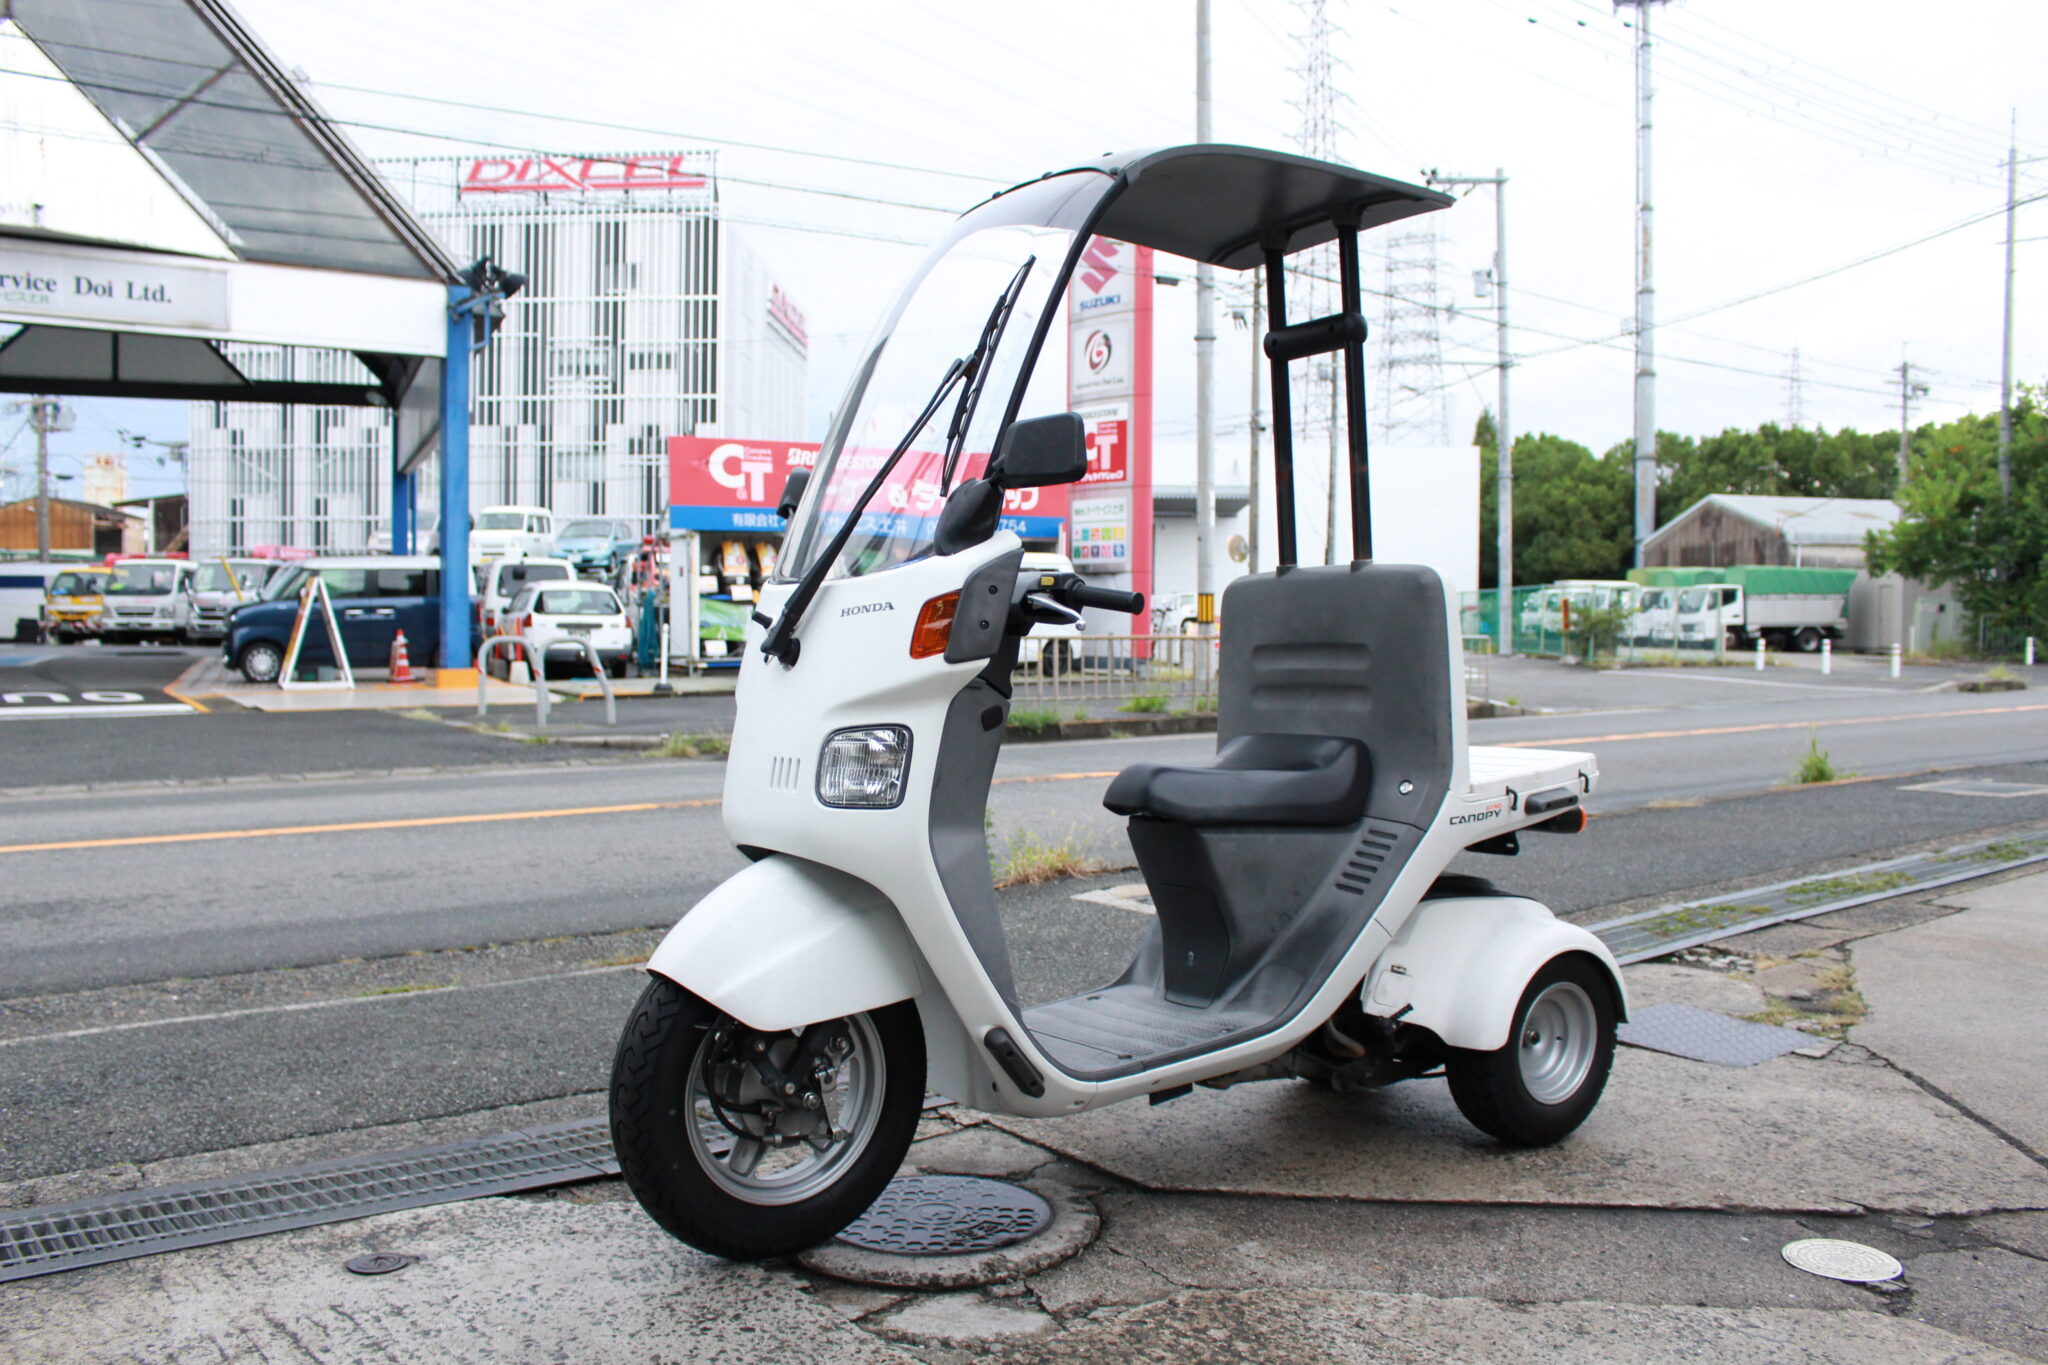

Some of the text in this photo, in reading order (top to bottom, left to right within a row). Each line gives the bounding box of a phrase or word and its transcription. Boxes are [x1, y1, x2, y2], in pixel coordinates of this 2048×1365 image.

[73, 275, 114, 298] Doi
[126, 281, 173, 303] Ltd.
[1080, 294, 1121, 310] SUZUKI
[840, 601, 894, 617] HONDA
[1450, 809, 1503, 825] CANOPY
